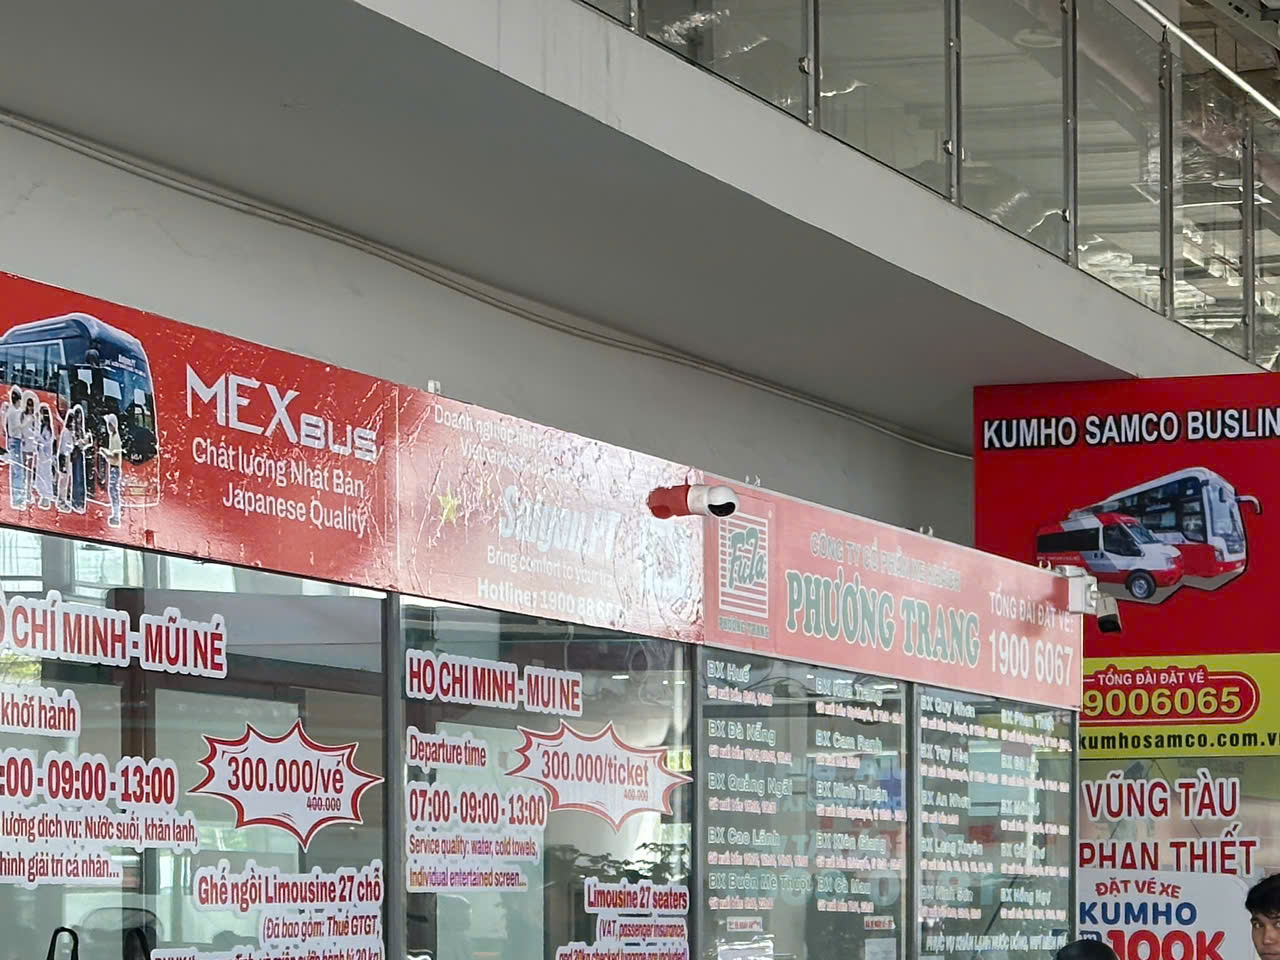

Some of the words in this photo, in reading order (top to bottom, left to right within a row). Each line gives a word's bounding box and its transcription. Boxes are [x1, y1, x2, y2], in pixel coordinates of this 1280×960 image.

[983, 417, 1077, 449] KUMHO
[1085, 411, 1179, 445] SAMCO
[192, 436, 236, 473] Chất
[238, 447, 285, 487] lượng
[290, 460, 331, 492] Nhật
[333, 469, 365, 498] Bản
[223, 483, 306, 522] Japanese
[310, 500, 367, 538] Quality
[487, 544, 517, 572] Bring
[810, 529, 844, 562] CÔNG
[846, 541, 861, 566] TY
[478, 577, 538, 611] Hotline:
[541, 591, 576, 616] 1900
[11, 600, 56, 651] CHÍ
[63, 611, 127, 660] MINH
[144, 616, 188, 667] MŨI
[194, 623, 224, 672] NÉ
[785, 567, 894, 651] PHƯƠNG
[901, 594, 980, 668] TRANG
[989, 629, 1029, 680] 1900
[1035, 639, 1073, 687] 6067
[409, 657, 436, 695] HO
[439, 661, 469, 699] CHI
[473, 666, 515, 704] MINH
[527, 673, 556, 708] MUI
[560, 677, 580, 712] NE
[1098, 668, 1132, 686] TỔNG
[1136, 671, 1157, 685] ĐÀI
[1159, 671, 1185, 685] ĐẶT
[1189, 669, 1205, 683] VÉ
[1, 692, 35, 728] khởi
[38, 697, 76, 732] hành
[1083, 687, 1241, 717] 9006065
[708, 720, 726, 738] BX
[410, 734, 463, 769] Departure
[464, 740, 487, 767] time
[541, 750, 649, 787] 300.000/ticket
[48, 760, 107, 801] 09:00
[121, 765, 175, 804] 13:00
[227, 756, 344, 794] 300.000/vé
[708, 772, 725, 790] BX
[410, 788, 450, 823] 07:00
[460, 792, 499, 824] 09:00
[509, 794, 545, 826] 13:00
[1085, 773, 1169, 818] VŨNG
[1178, 772, 1237, 818] TÀU
[2, 811, 35, 843] lượng
[38, 813, 62, 845] dịch
[64, 819, 82, 845] vụ:
[85, 815, 114, 840] Nước
[116, 811, 142, 844] suối,
[144, 816, 171, 841] khăn
[173, 817, 198, 847] lạnh,
[409, 834, 439, 855] Service
[440, 835, 469, 859] quality:
[494, 838, 511, 856] cold
[708, 827, 726, 844] BX
[727, 827, 750, 845] Cao
[28, 853, 49, 883] giải
[51, 852, 64, 877] trí
[65, 854, 79, 878] cá
[1079, 842, 1159, 870] PHAN
[1169, 824, 1257, 875] THIẾT
[199, 866, 228, 905] Ghế
[231, 868, 262, 912] ngồi
[265, 875, 336, 905] Limousine
[339, 876, 354, 903] 27
[357, 866, 381, 901] chỗ
[409, 866, 448, 888] Individual
[449, 867, 493, 887] entertained
[1095, 877, 1132, 898] ĐẶT
[1134, 877, 1157, 895] VÉ
[1159, 882, 1181, 899] XE
[587, 883, 637, 909] Limousine
[639, 886, 651, 909] 27
[652, 887, 688, 910] seaters
[1079, 902, 1198, 925] KUMHO
[281, 917, 300, 939] bao
[618, 921, 653, 942] passenger
